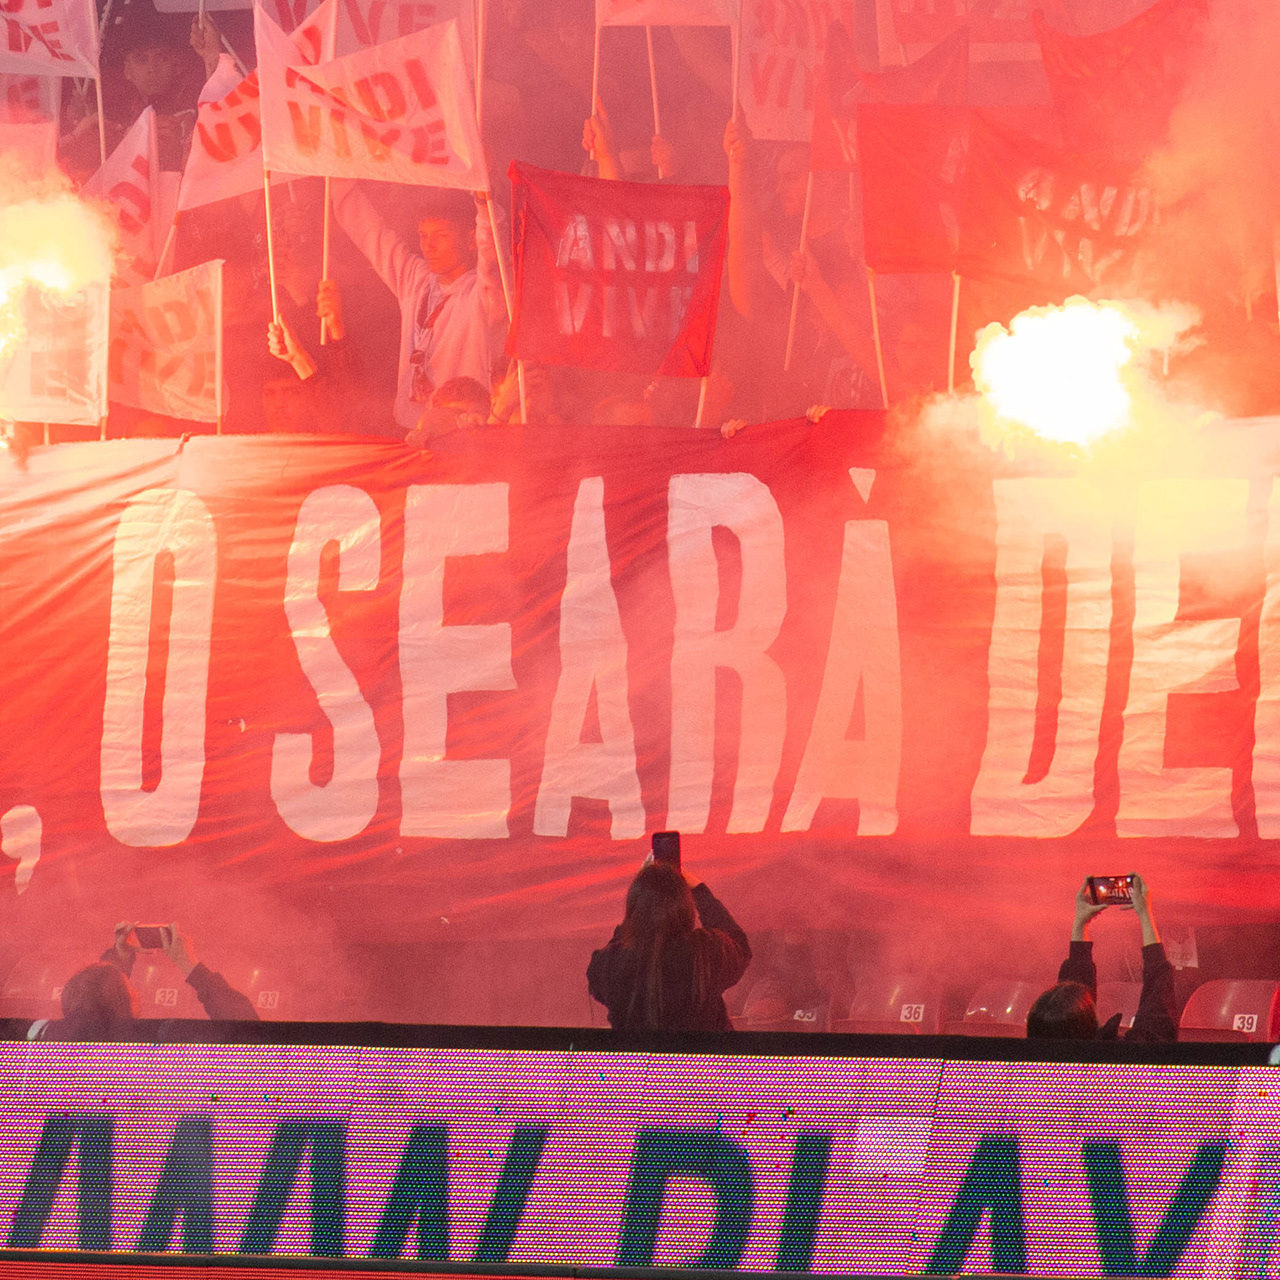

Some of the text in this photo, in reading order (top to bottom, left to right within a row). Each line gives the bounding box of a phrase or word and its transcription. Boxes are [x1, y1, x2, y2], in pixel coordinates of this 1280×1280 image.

[556, 216, 700, 271] ANDI
[100, 488, 217, 848] O
[157, 989, 175, 1005] 32
[903, 1006, 922, 1021] 36
[1236, 1016, 1256, 1031] 39
